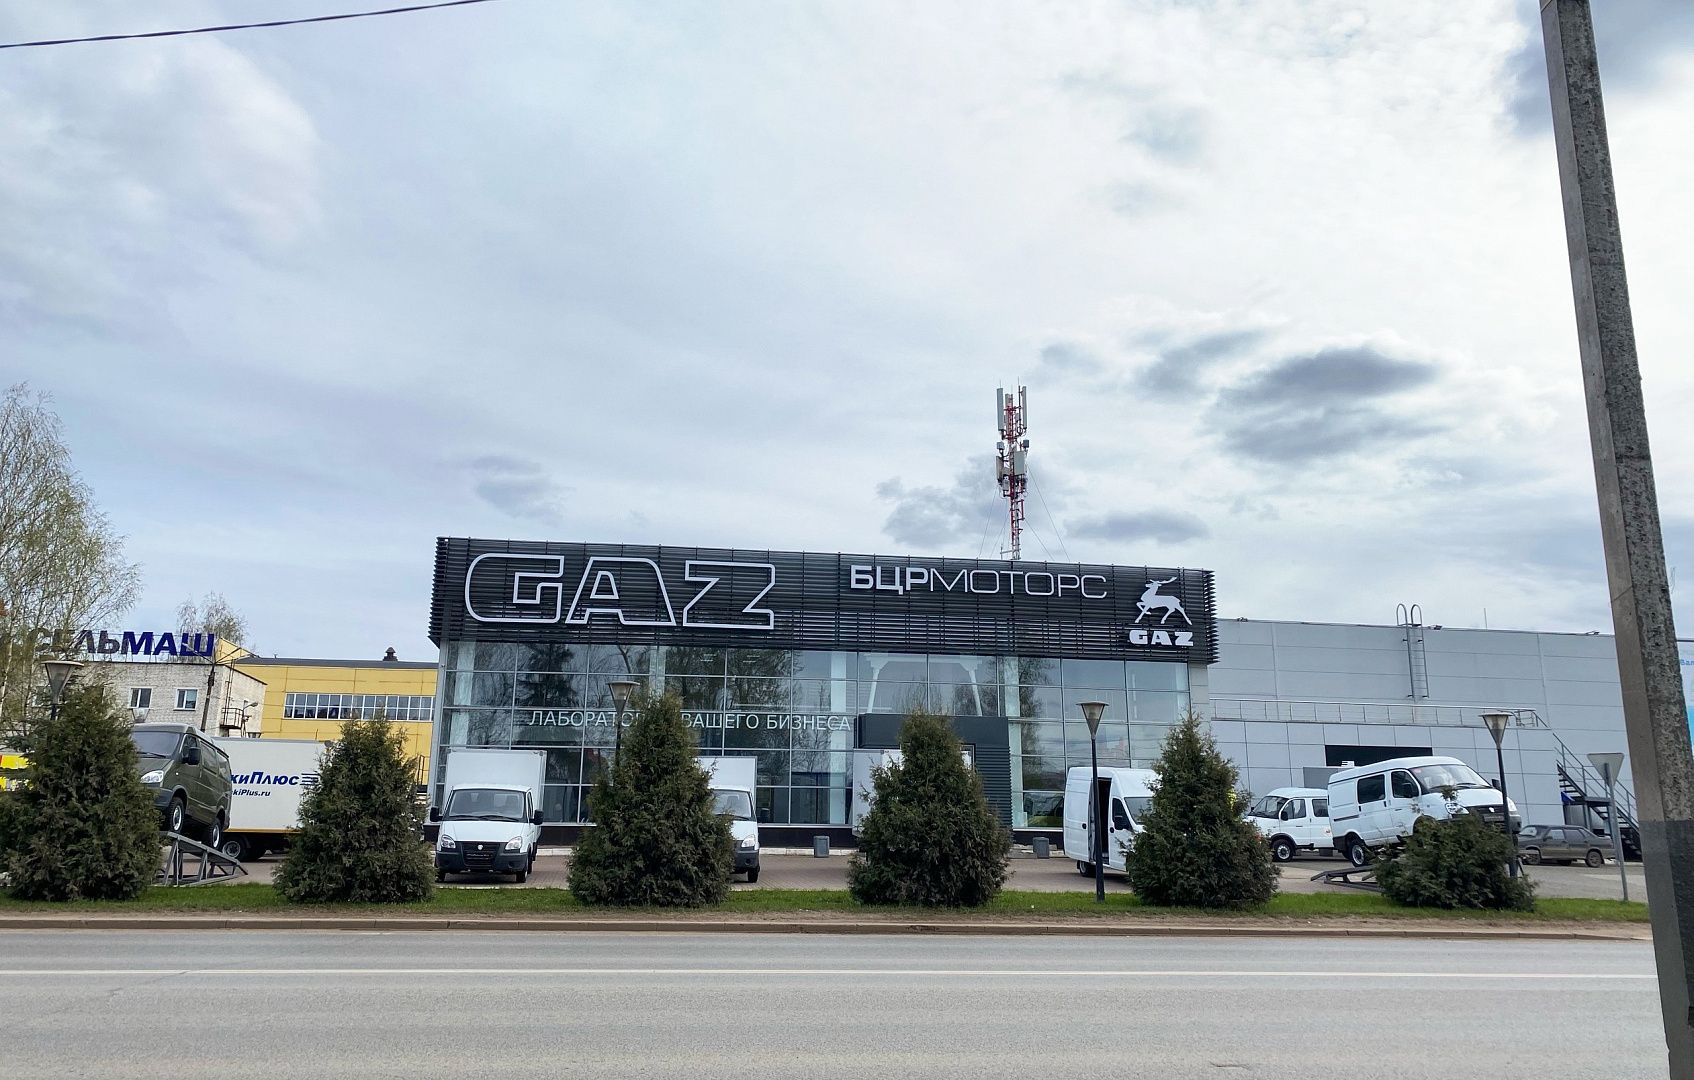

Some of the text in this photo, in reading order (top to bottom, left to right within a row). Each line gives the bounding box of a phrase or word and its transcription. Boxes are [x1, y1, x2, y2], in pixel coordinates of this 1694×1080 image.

[465, 552, 775, 630] GAZ
[1129, 629, 1194, 647] GAZ
[529, 711, 850, 731] ЛАБОРАТОР ВАШЕГО БИЗНЕСА
[231, 771, 299, 785] киПлюс
[231, 789, 271, 797] kiPlus.ru
